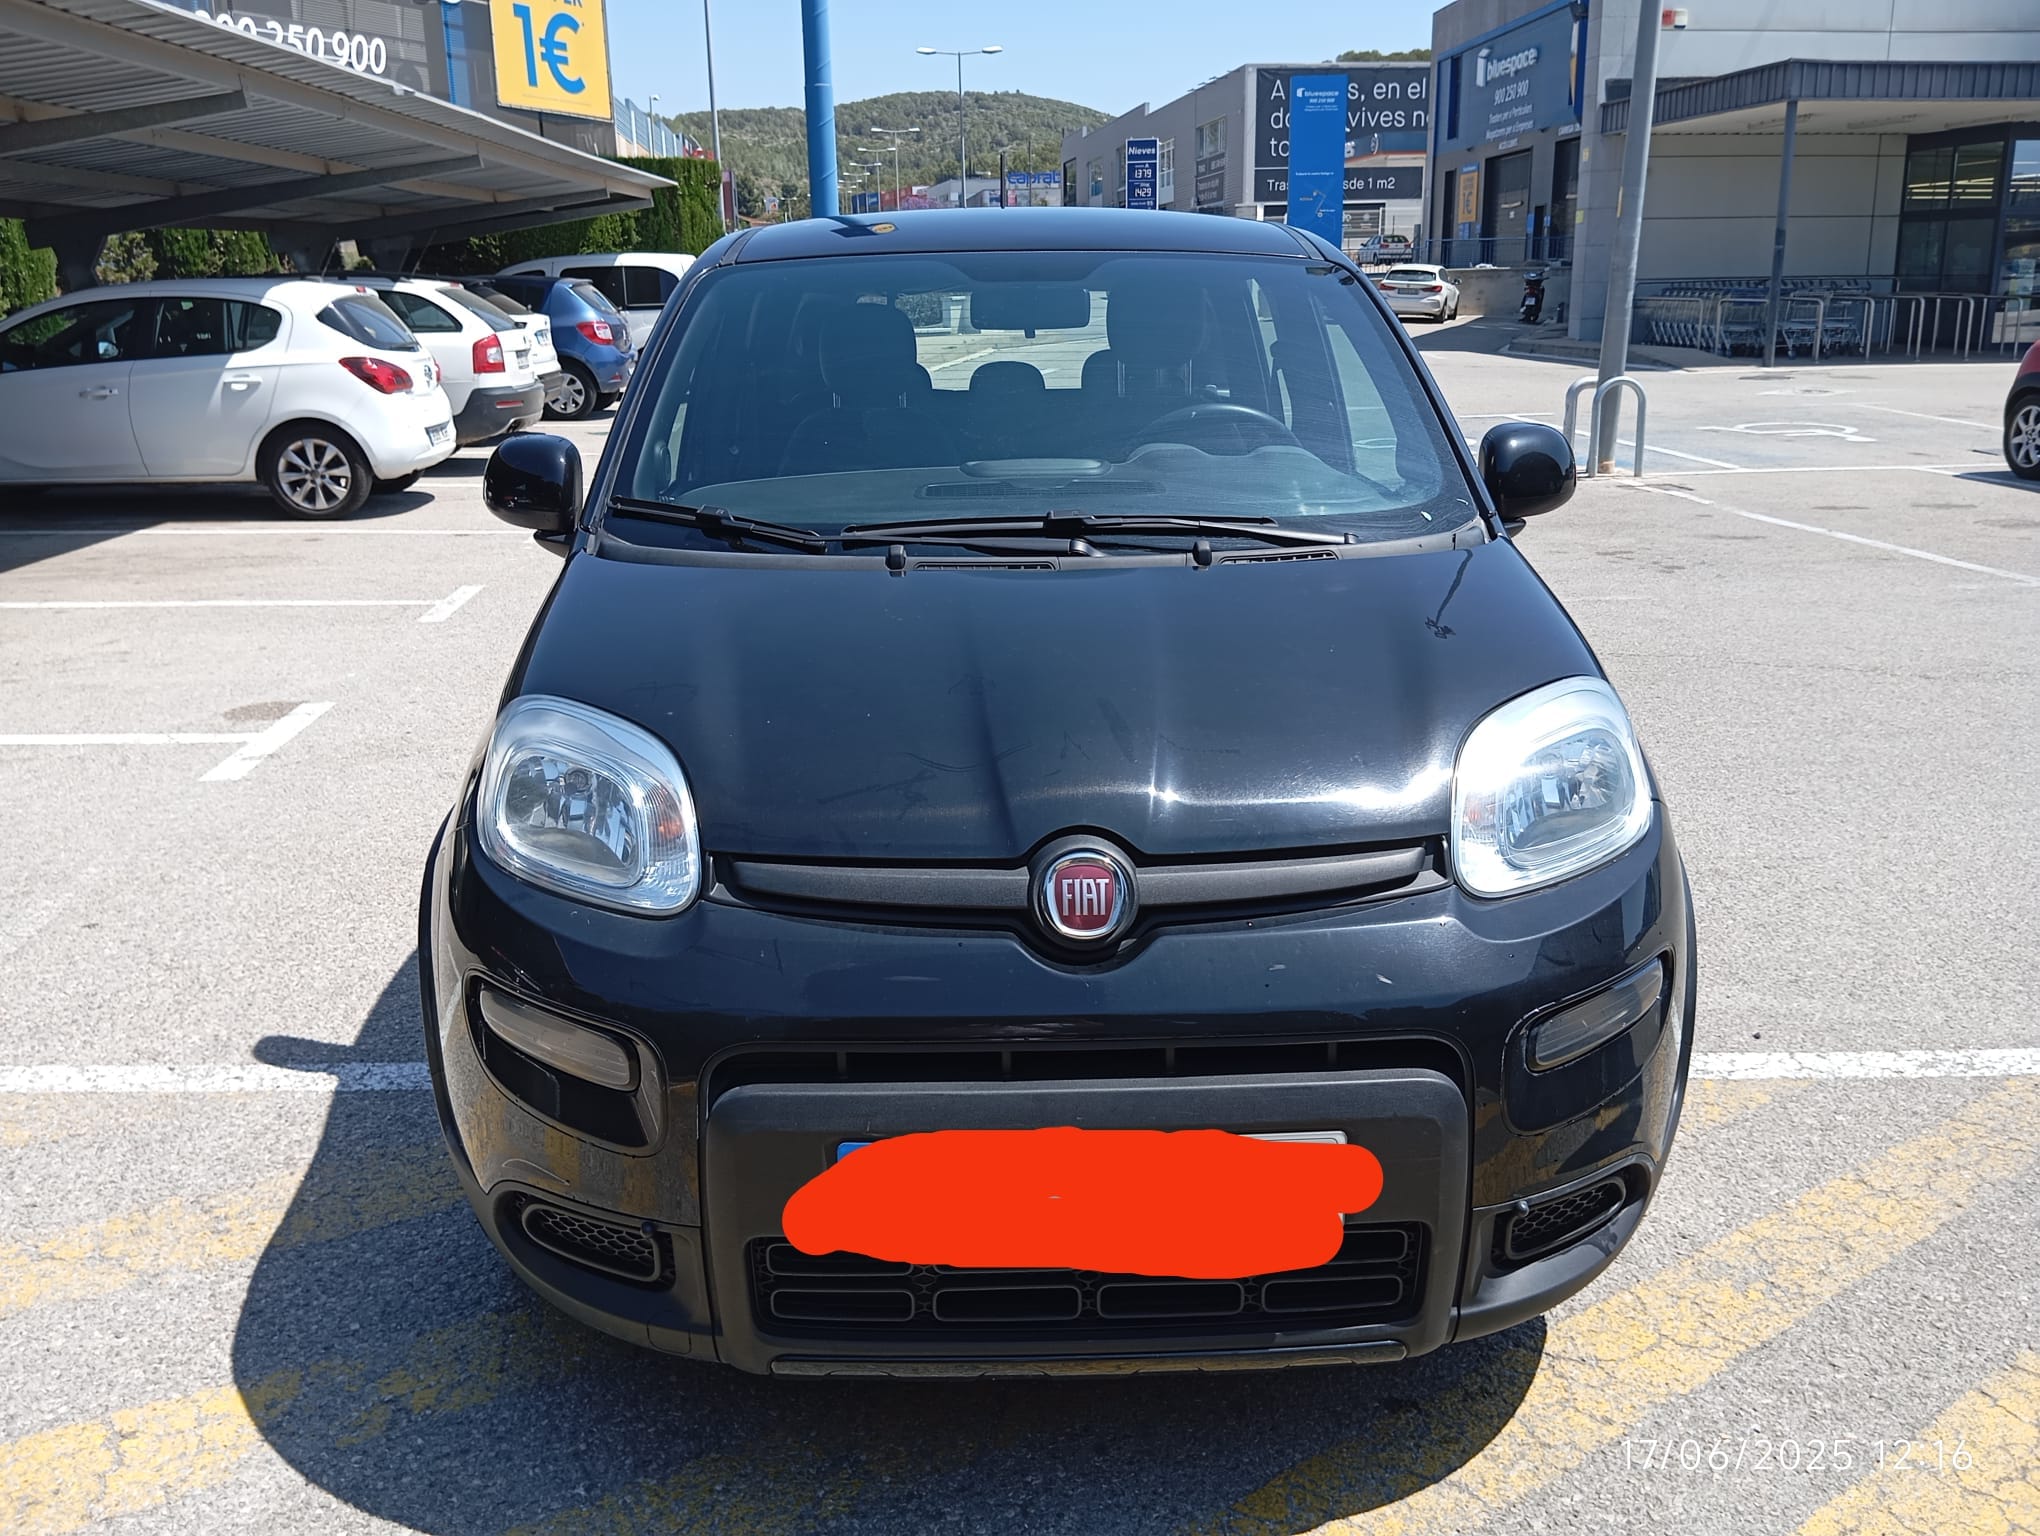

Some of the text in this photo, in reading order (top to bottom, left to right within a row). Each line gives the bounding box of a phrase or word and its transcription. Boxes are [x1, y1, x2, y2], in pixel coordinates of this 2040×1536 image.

[332, 31, 387, 75] 900
[512, 3, 586, 95] 1€
[1486, 47, 1539, 82] bluespace
[1270, 79, 1286, 101] A
[1373, 81, 1401, 100] en
[1407, 76, 1427, 100] el
[1348, 107, 1406, 128] vives
[1128, 146, 1156, 155] Nieves
[1342, 177, 1396, 190] sde 1 m2
[1061, 878, 1110, 917] FIAT
